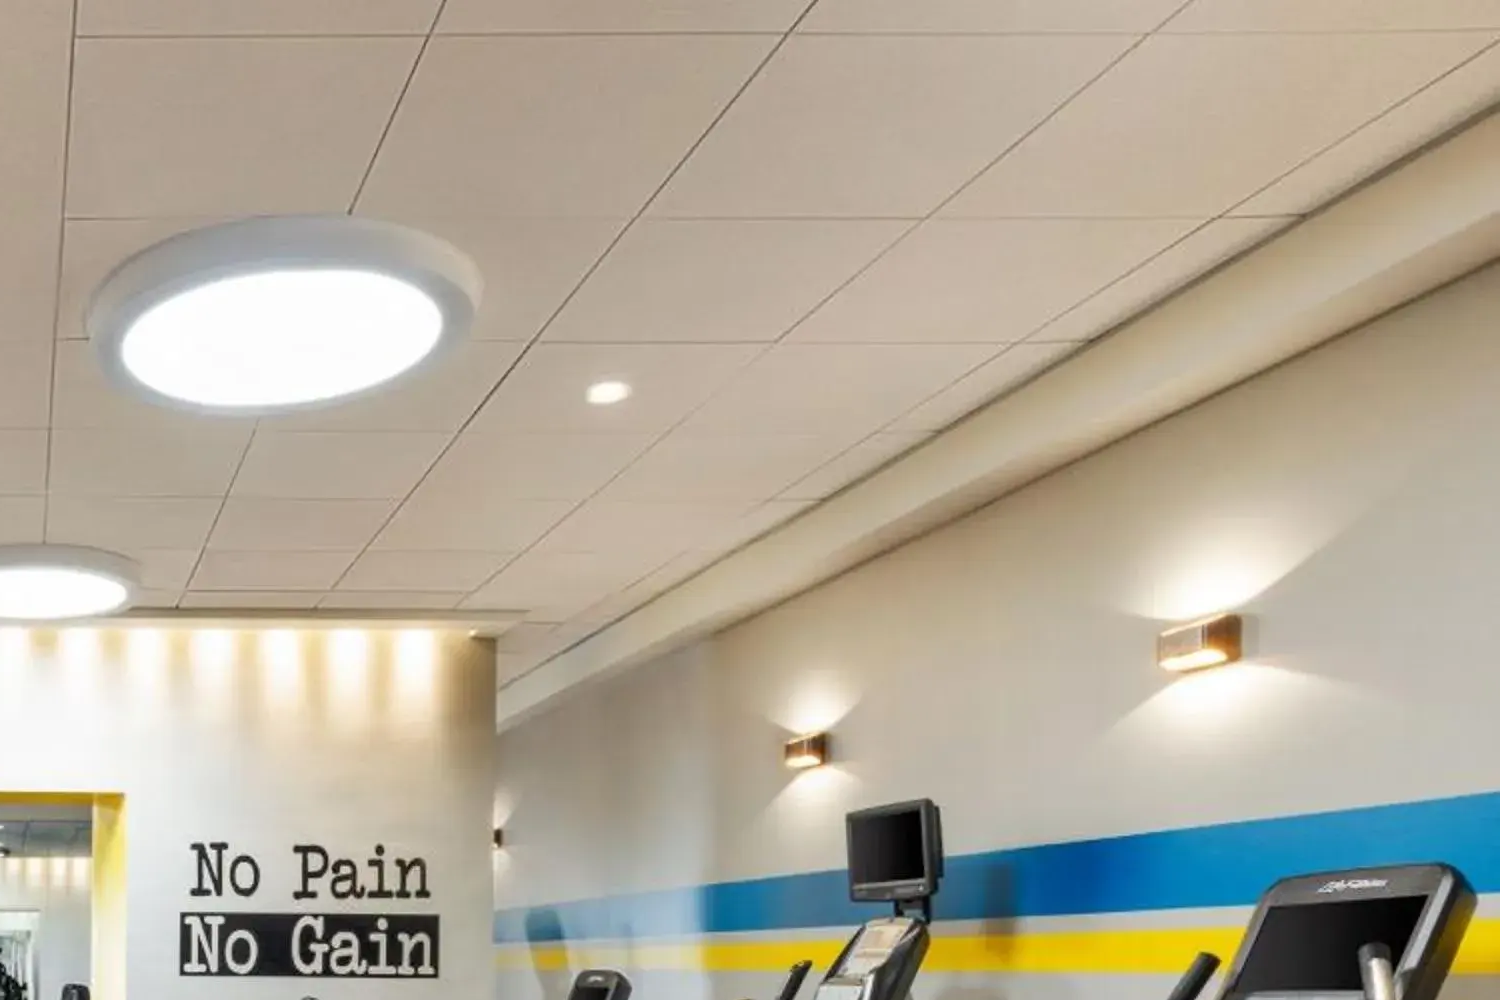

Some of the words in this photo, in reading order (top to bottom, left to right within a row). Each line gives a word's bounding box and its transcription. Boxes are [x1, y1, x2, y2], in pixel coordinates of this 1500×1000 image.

[190, 842, 260, 897] No
[293, 844, 431, 899] Pain
[183, 915, 258, 974] No
[291, 915, 435, 976] Gain
